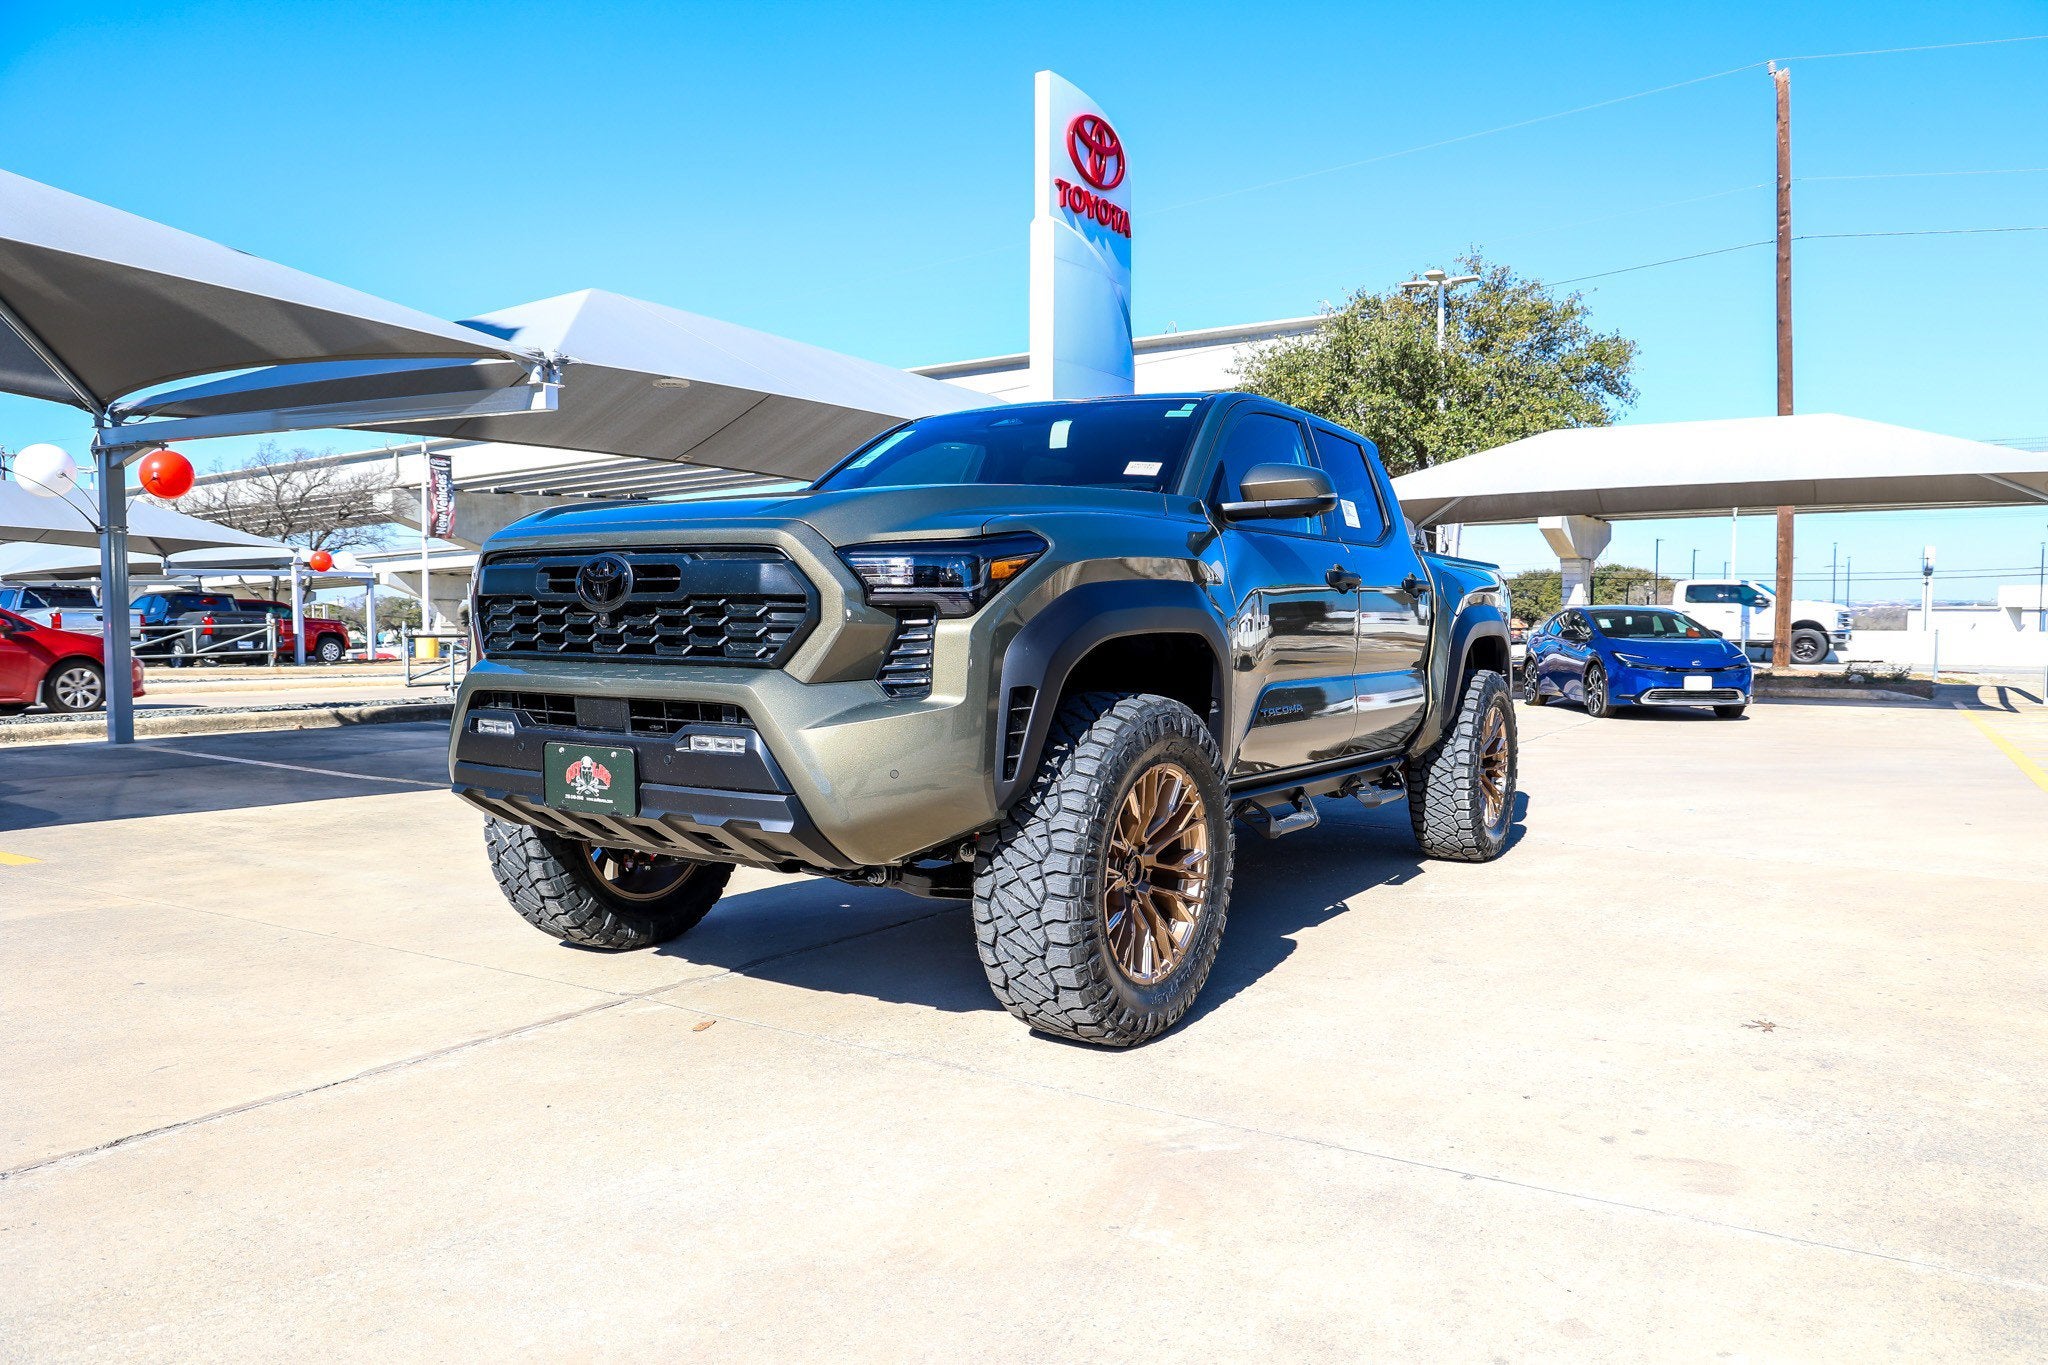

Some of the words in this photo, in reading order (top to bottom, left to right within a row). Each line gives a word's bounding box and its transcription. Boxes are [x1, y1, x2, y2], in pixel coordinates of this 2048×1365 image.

[1054, 178, 1131, 238] TOYOTA
[435, 473, 448, 513] Vehicles
[435, 514, 448, 534] New
[1259, 704, 1304, 718] TACOMA
